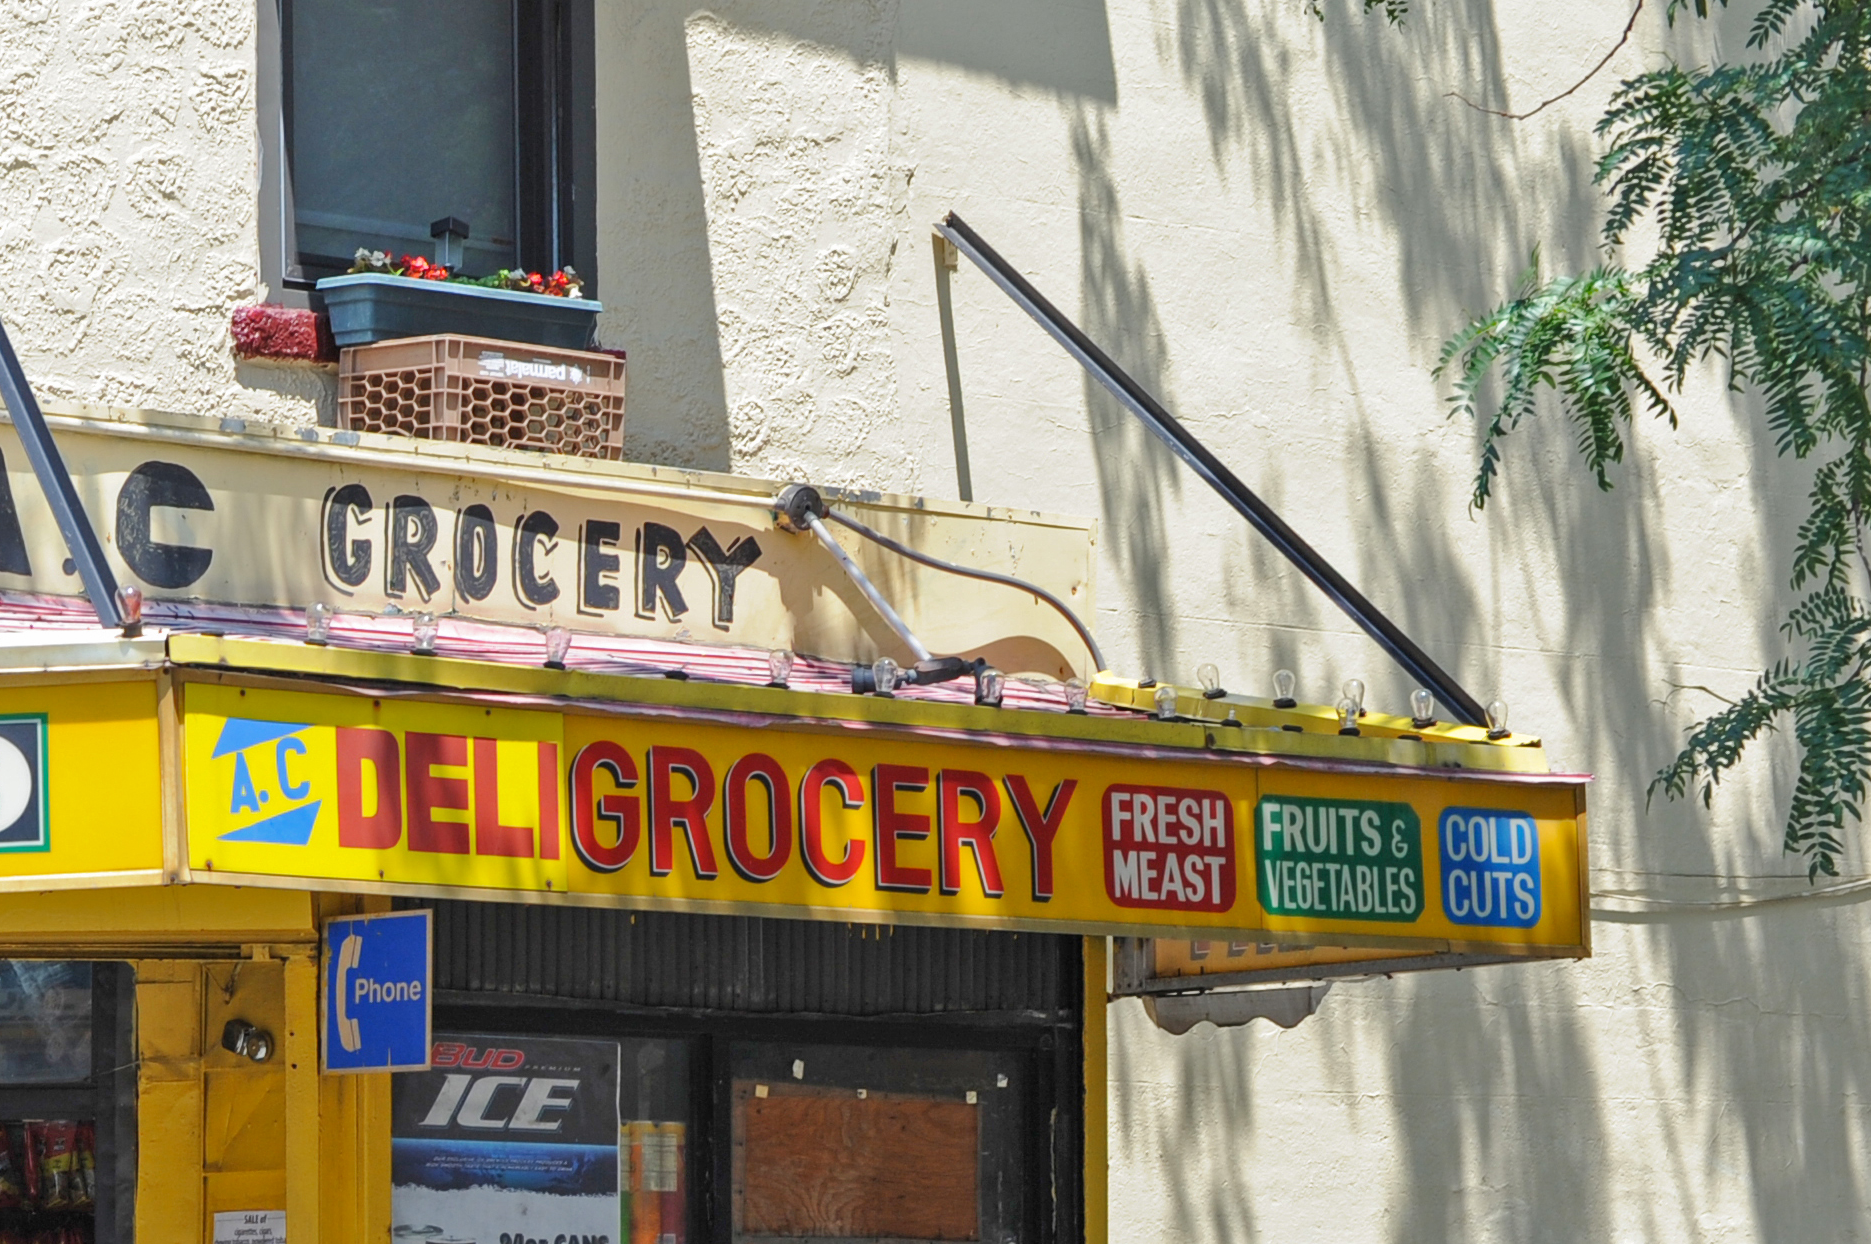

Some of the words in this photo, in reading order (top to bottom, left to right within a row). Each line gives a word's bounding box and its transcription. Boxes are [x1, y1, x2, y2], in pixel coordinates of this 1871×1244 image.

[322, 482, 763, 632] GROCERY
[335, 726, 559, 861] DELI
[570, 740, 1078, 902] GROCERY
[1110, 792, 1226, 848] FRESH
[1262, 802, 1381, 858] FRUITS
[1391, 824, 1408, 858] &
[1445, 814, 1532, 864] COLD
[1112, 851, 1227, 906] MEAST
[1265, 860, 1416, 915] VEGETABLES
[1449, 868, 1536, 921] CUTS
[355, 978, 421, 1004] Phone
[431, 1042, 525, 1071] BUD
[418, 1074, 580, 1133] ICE
[244, 1215, 258, 1224] SALE
